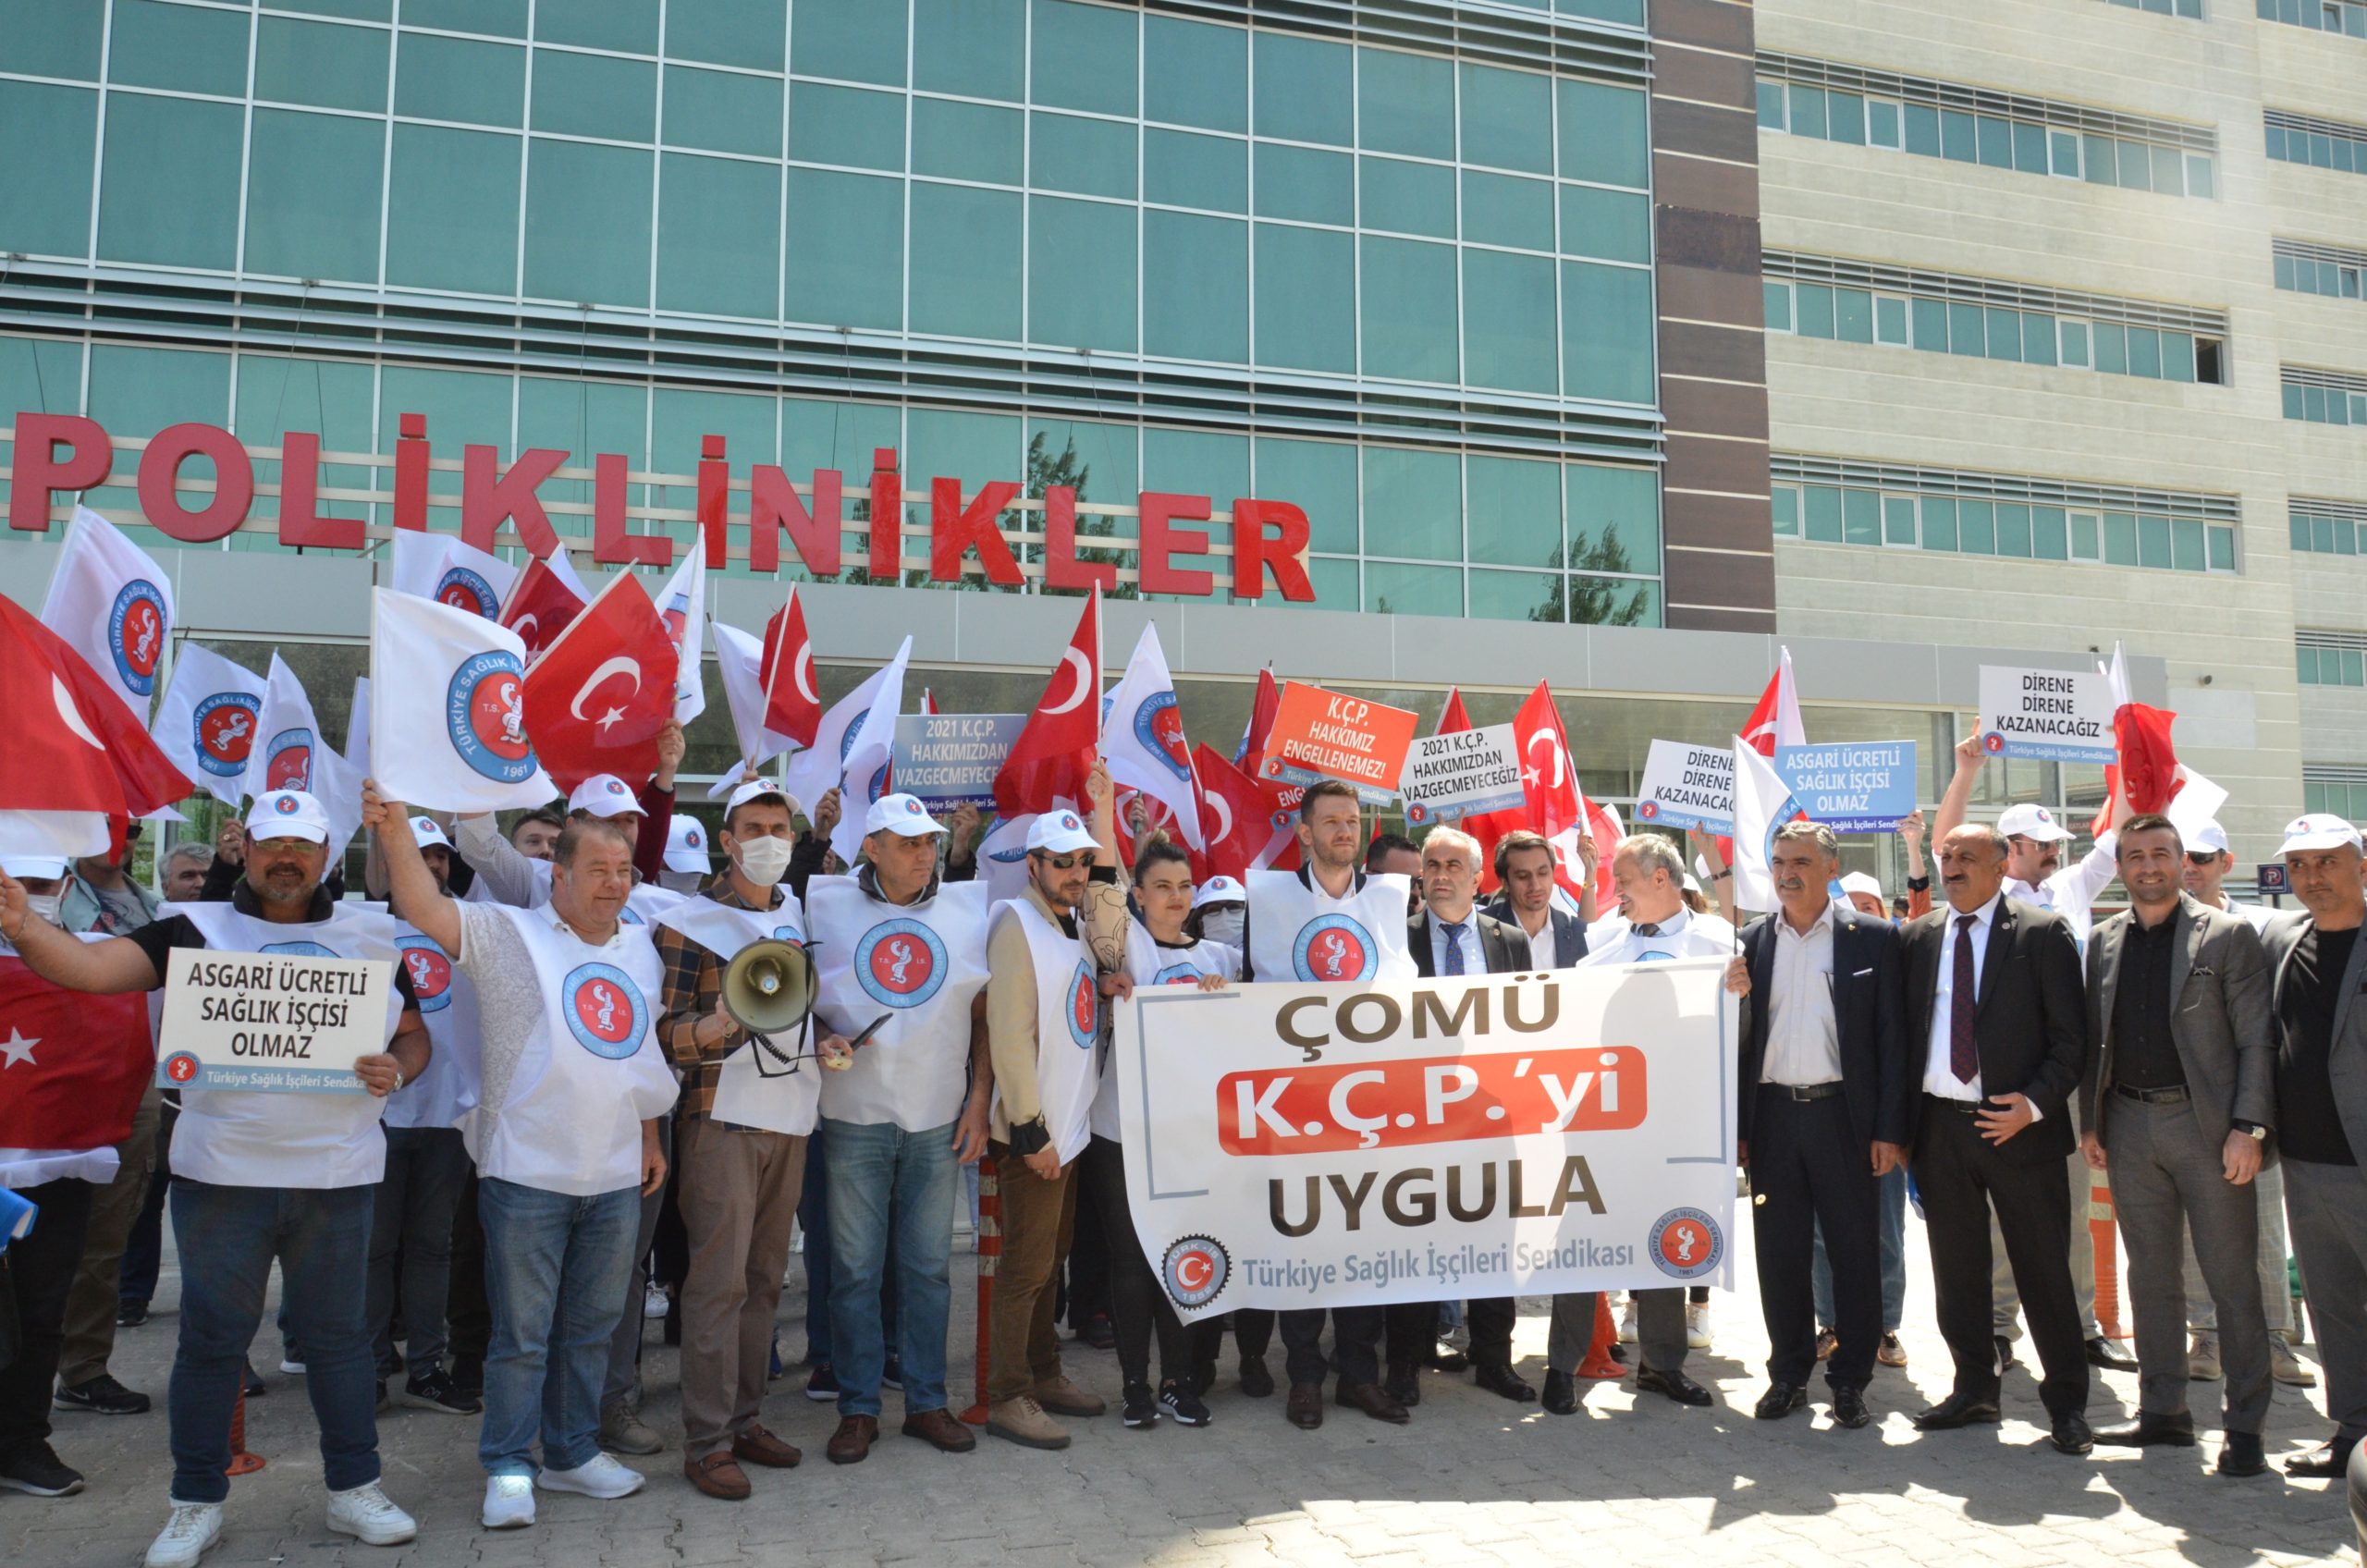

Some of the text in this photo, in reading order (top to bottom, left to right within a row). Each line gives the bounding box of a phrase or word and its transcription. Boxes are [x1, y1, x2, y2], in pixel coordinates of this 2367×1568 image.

[8, 411, 1317, 603] POLİKLİNİKLER
[2023, 672, 2074, 693] DİRENE
[451, 657, 509, 755] TÜRKİYE SAĞLIK
[1138, 696, 1165, 728] TÜRKİYE
[1327, 695, 1369, 728] K.Ç.P.
[2023, 693, 2074, 715] DİRENE
[926, 719, 997, 741] 2021 K.Ç.P.
[1308, 720, 1376, 753] HAKKIMIZ
[1996, 715, 2100, 738] KAZANACAĞIZ
[912, 742, 1009, 762] HAKKIMIZDAN
[1421, 732, 1489, 757] 2021 K.Ç.P.
[2009, 745, 2114, 761] Türkiye Sağlık İşçileri Sendikası
[1282, 739, 1387, 780] ENGELLENEMEZ!
[1413, 750, 1503, 779] HAKKIMIZDAN
[1686, 749, 1734, 772] DİRENE
[1786, 745, 1901, 770] ASGARİ ÜCRETLİ
[502, 764, 529, 778] 1961
[895, 765, 1000, 786] VAZGECMEYECE
[1286, 769, 1314, 786] Türkiye
[1683, 768, 1733, 791] DİRENE
[1797, 768, 1891, 793] SAĞLIK İŞÇİSİ
[1404, 766, 1520, 802] VAZGECMEYECEĞİZ
[921, 799, 944, 810] ürkiye
[1817, 794, 1870, 812] OLMAZ
[1662, 814, 1686, 827] Türkiye
[1706, 820, 1728, 832] İşçileri
[1831, 820, 1853, 831] Sağlık
[1854, 819, 1877, 831] İşçileri
[188, 961, 368, 996] ASGARİ ÜCRETLİ
[202, 992, 349, 1032] SAĞLIK İŞÇİSİ
[1275, 974, 1561, 1062] ÇOMÜ
[232, 1032, 313, 1059] OLMAZ
[206, 1071, 364, 1089] Türkiye Sağlık İşçileri Sendika
[1268, 1155, 1607, 1238] UYGULA
[1651, 1210, 1720, 1266] TÜRKİYE SAĞLIK İŞÇİLERİ SENDİKASI
[1242, 1238, 1635, 1293] Türkiye Sağlık İşçileri Sendikası
